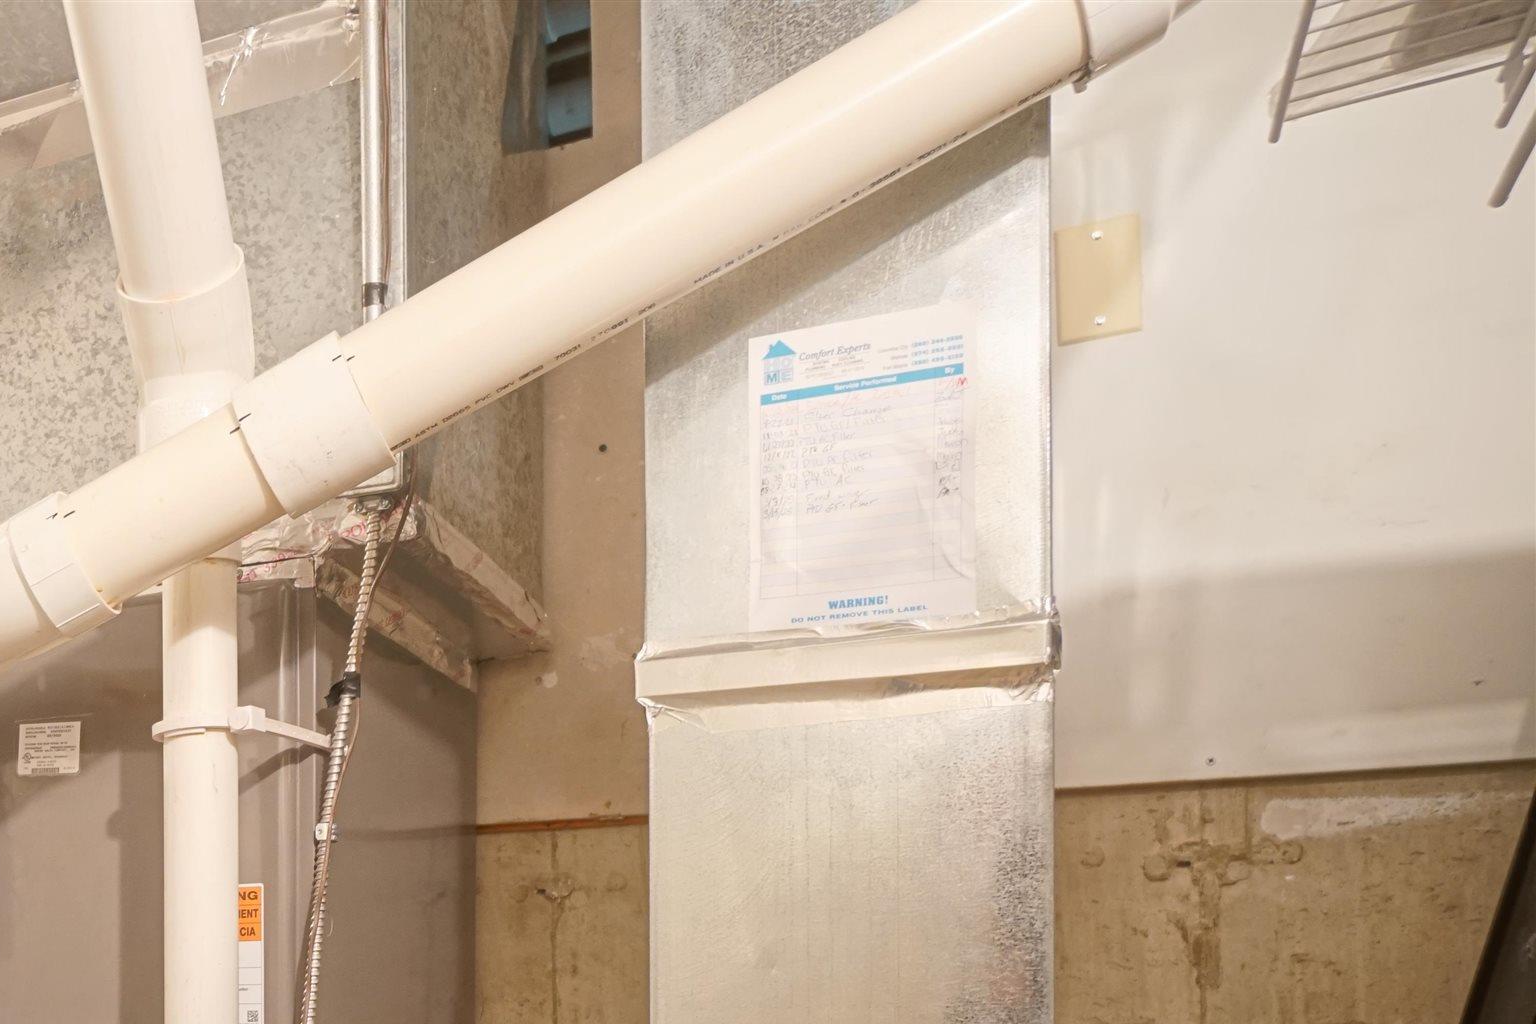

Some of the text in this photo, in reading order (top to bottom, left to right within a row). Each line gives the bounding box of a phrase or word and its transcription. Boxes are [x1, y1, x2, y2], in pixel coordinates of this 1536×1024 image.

[799, 348, 835, 361] Comfort
[837, 342, 871, 355] Experts
[944, 367, 956, 375] By
[834, 376, 897, 391] Service Performed
[828, 595, 888, 609] WARNING!
[829, 610, 868, 620] REMOVE
[872, 608, 894, 616] THIS
[897, 604, 928, 613] LABEL
[239, 926, 256, 937] CIA
